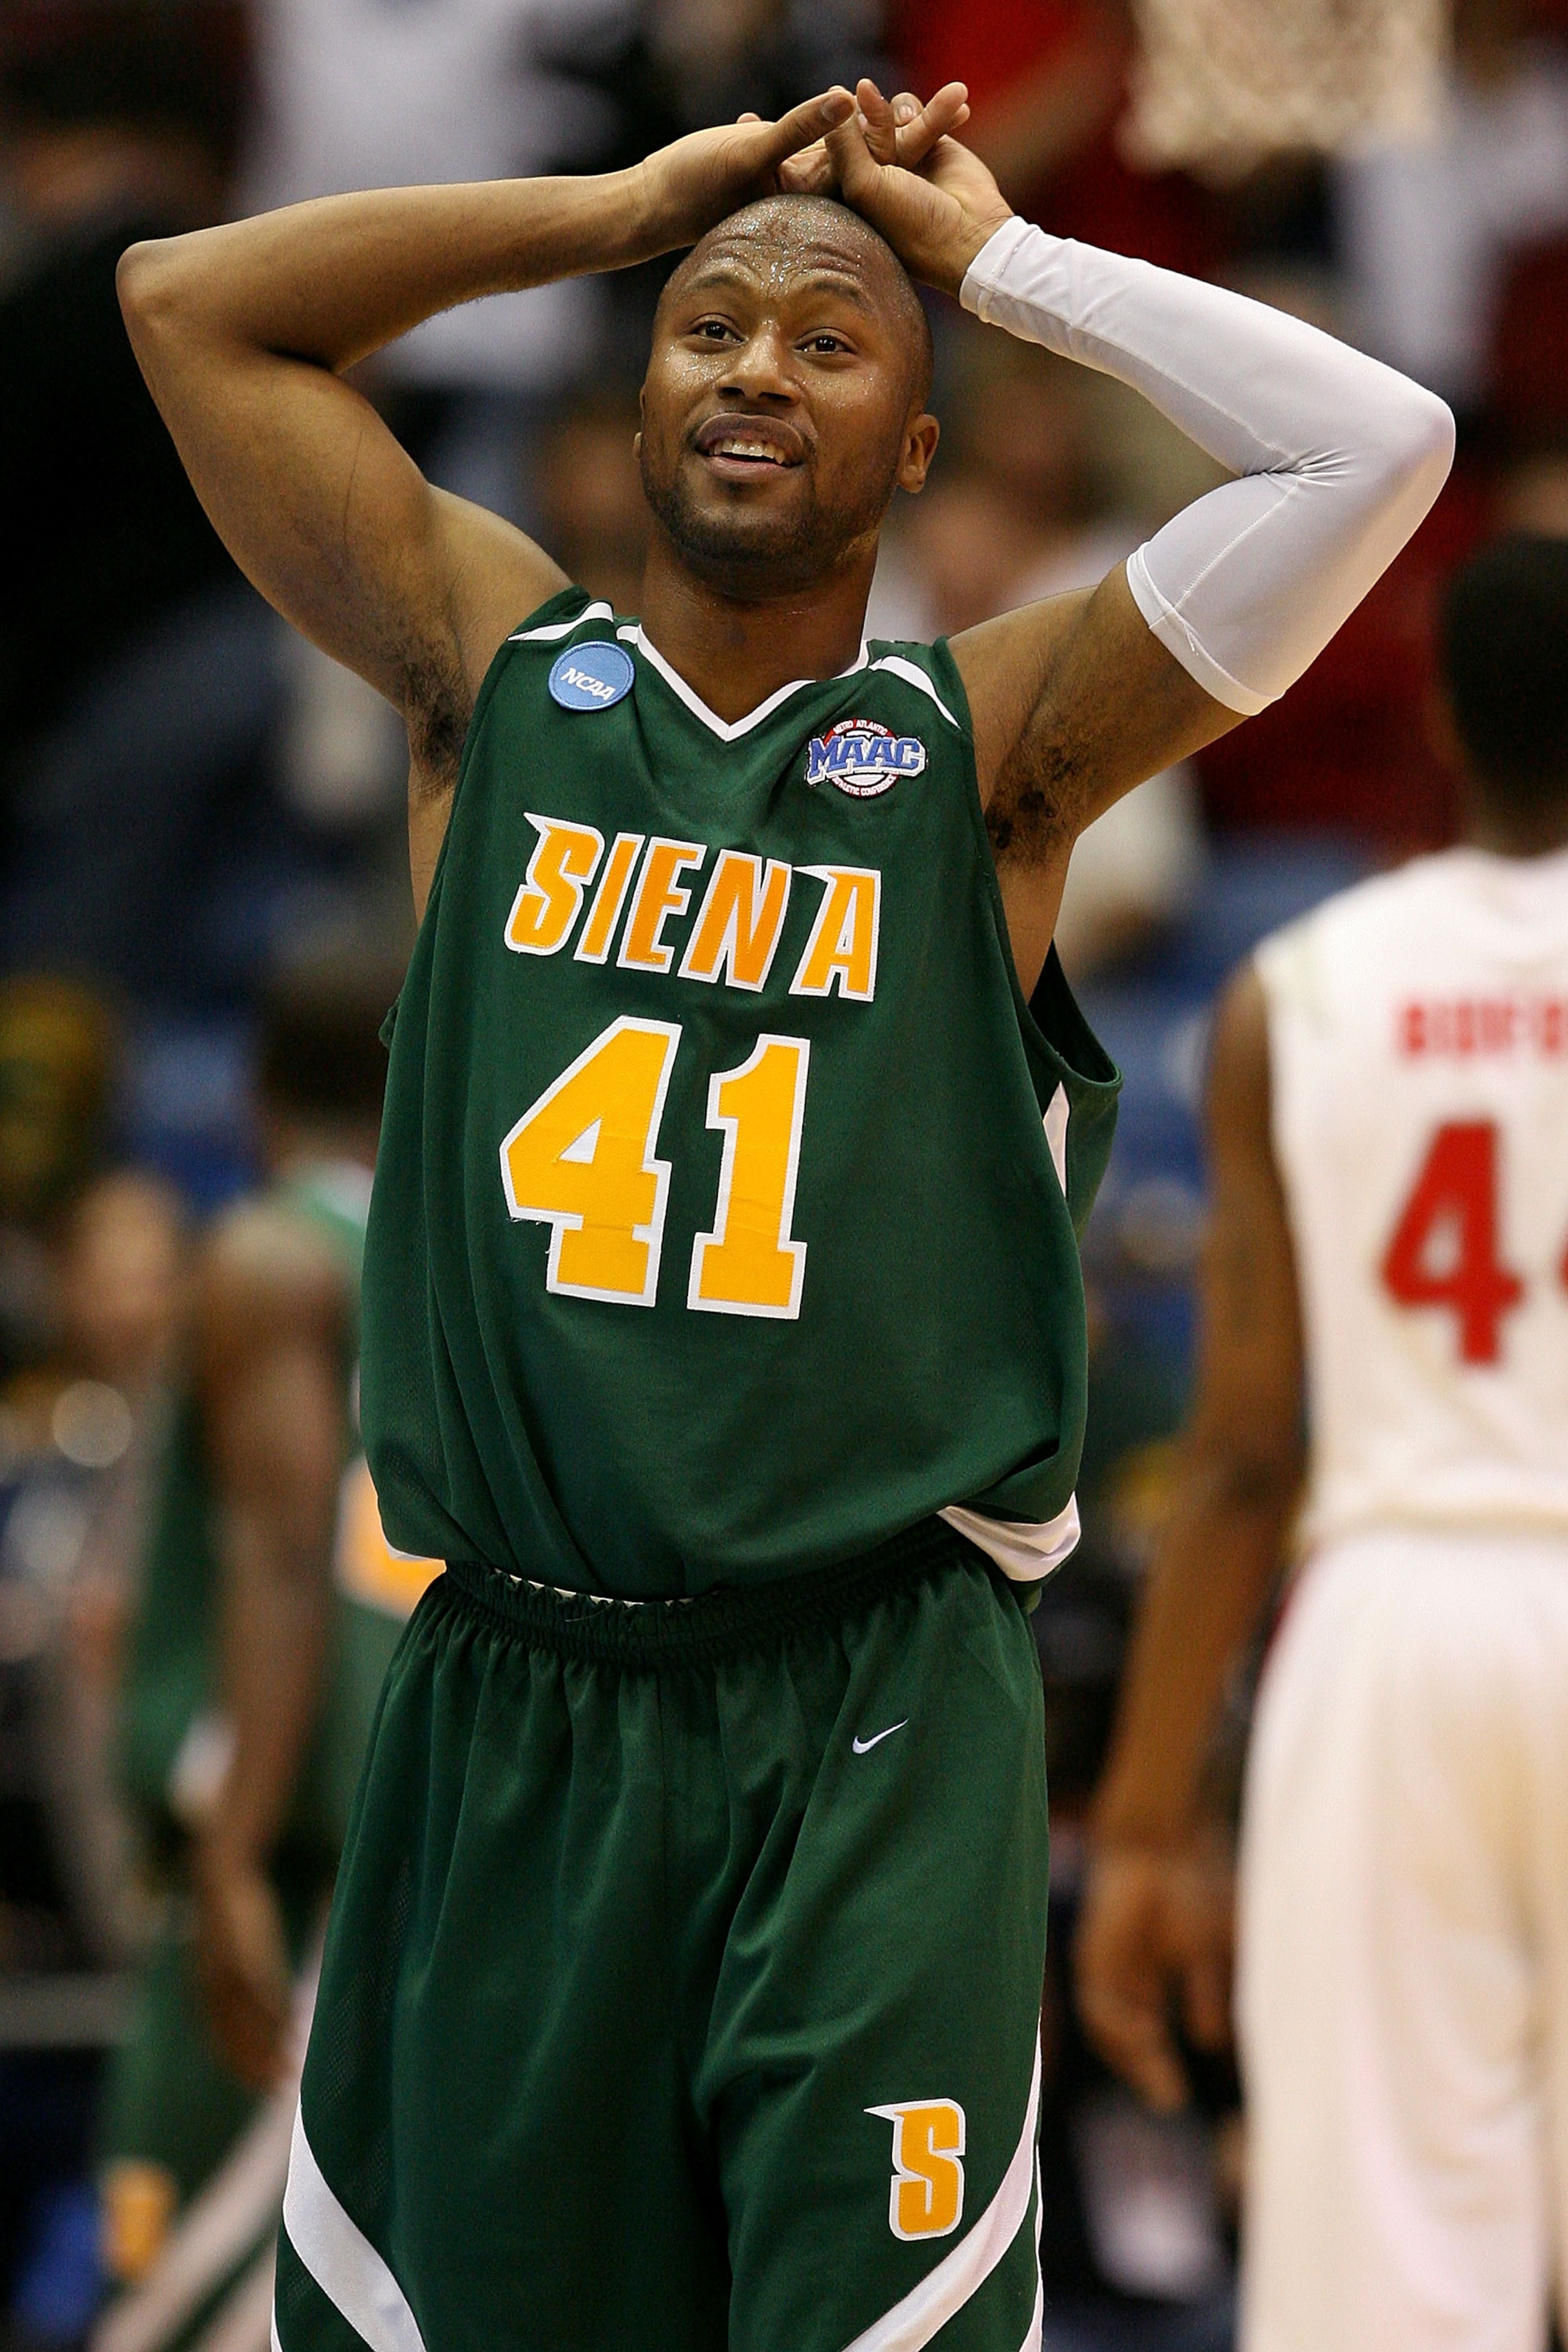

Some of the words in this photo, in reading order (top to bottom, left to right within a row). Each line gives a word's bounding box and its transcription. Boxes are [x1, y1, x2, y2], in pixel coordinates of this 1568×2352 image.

[560, 667, 616, 701] NCAA
[856, 719, 888, 736] ATLANTIC
[807, 736, 925, 784] MAAC
[504, 813, 881, 1001] SIENA
[499, 1015, 811, 1320] 41
[863, 2098, 966, 2242] S
